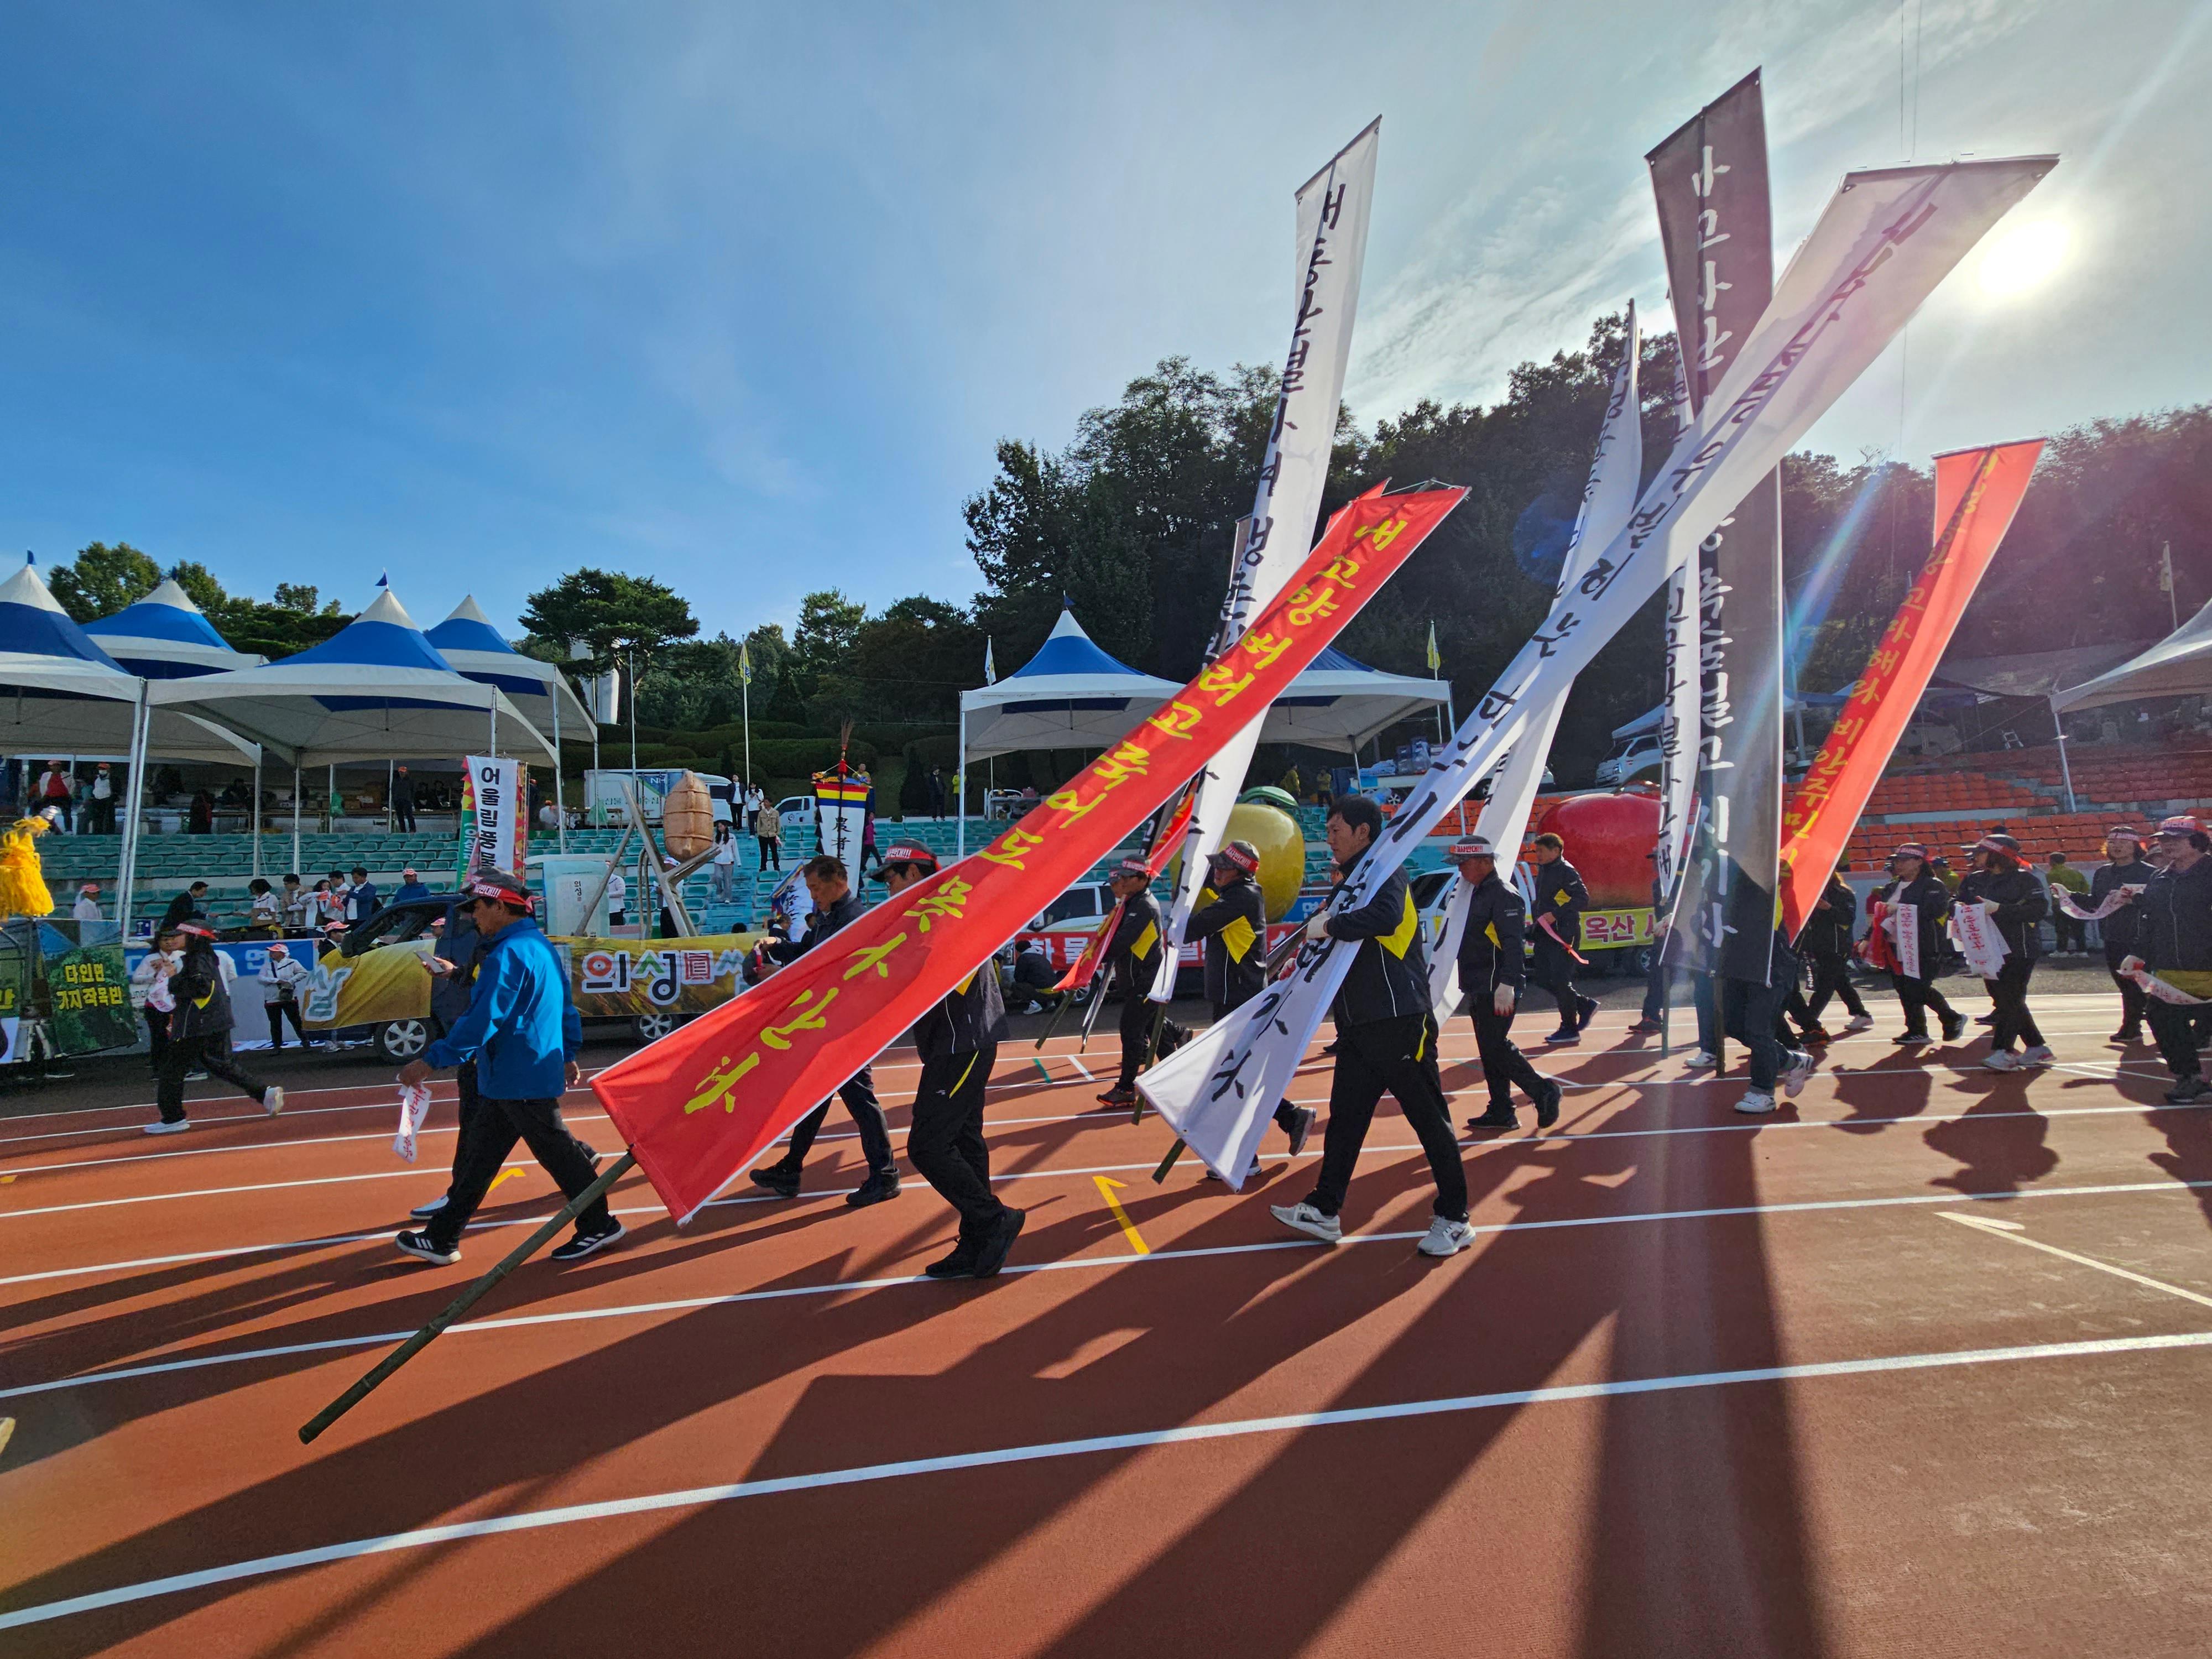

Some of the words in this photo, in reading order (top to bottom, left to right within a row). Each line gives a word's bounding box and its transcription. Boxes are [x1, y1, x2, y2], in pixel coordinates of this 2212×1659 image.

[1147, 629, 1292, 739] 버리고
[980, 741, 1148, 869] 죽어도
[574, 880, 582, 896] 의성
[1585, 915, 1635, 942] 옥산
[65, 963, 106, 983] 다인면
[56, 986, 124, 1010] 가지작목반
